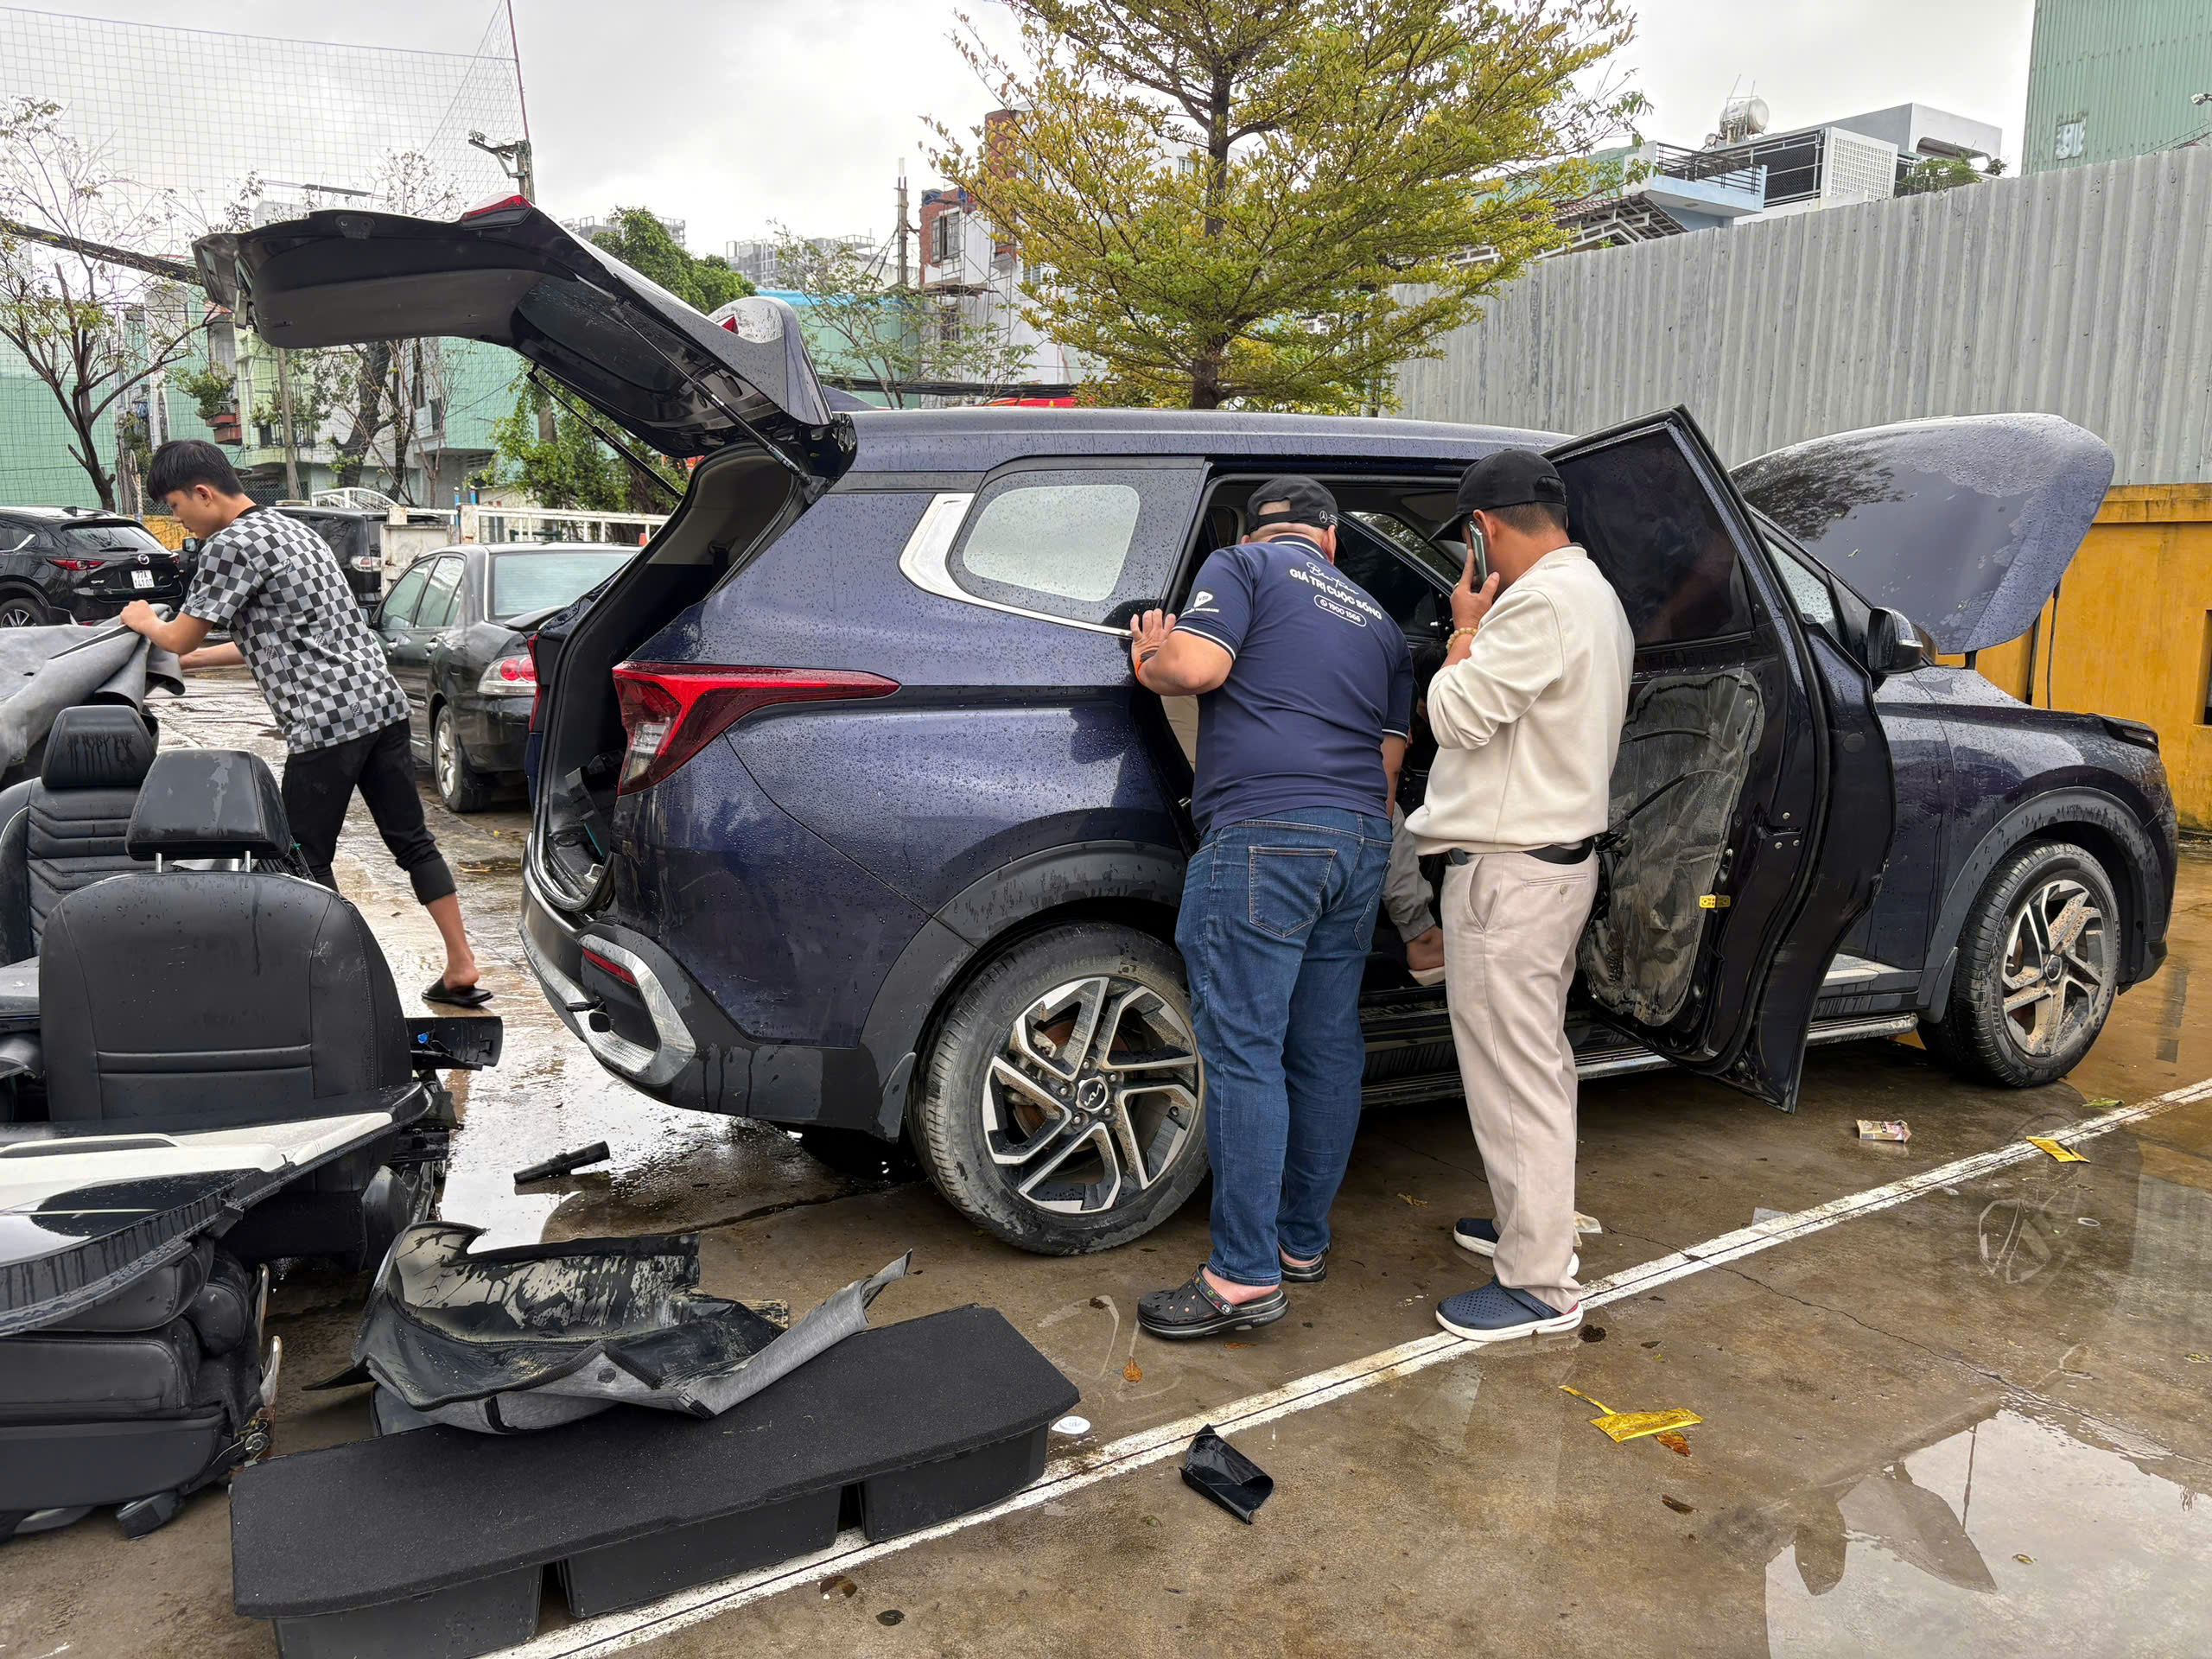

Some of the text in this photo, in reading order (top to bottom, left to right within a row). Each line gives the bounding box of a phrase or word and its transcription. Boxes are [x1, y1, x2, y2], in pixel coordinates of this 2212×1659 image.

[1289, 569, 1382, 620] GIÁ TRỊ CUỘC SỐNG
[1328, 602, 1344, 615] 1900
